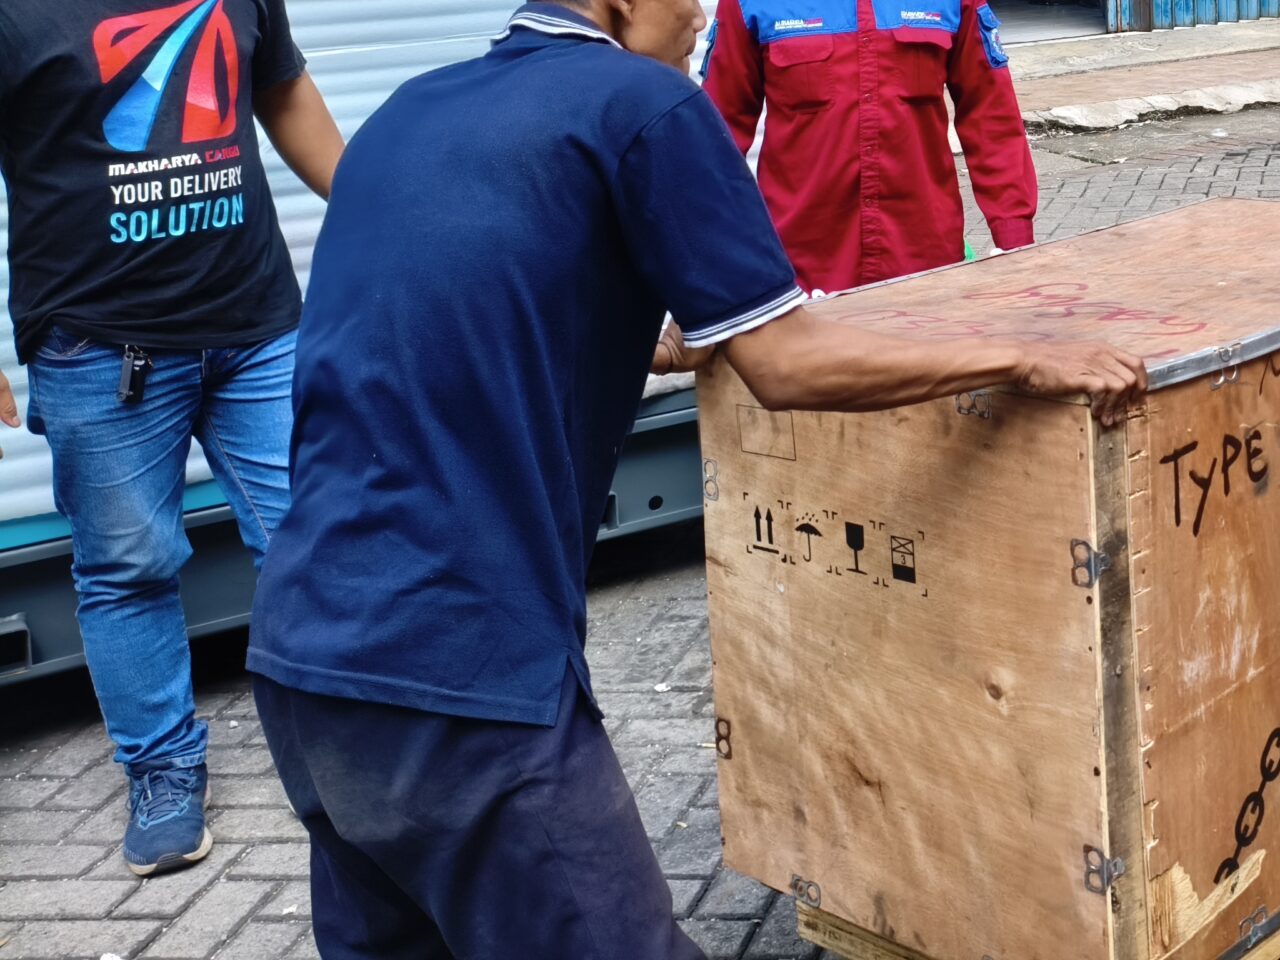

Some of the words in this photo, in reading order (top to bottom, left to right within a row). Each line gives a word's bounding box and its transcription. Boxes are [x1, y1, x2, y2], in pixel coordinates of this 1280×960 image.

[109, 153, 202, 176] MAKHARYA
[110, 180, 164, 205] YOUR
[170, 165, 242, 199] DELIVERY
[110, 193, 244, 243] SOLUTION
[900, 554, 907, 566] 3
